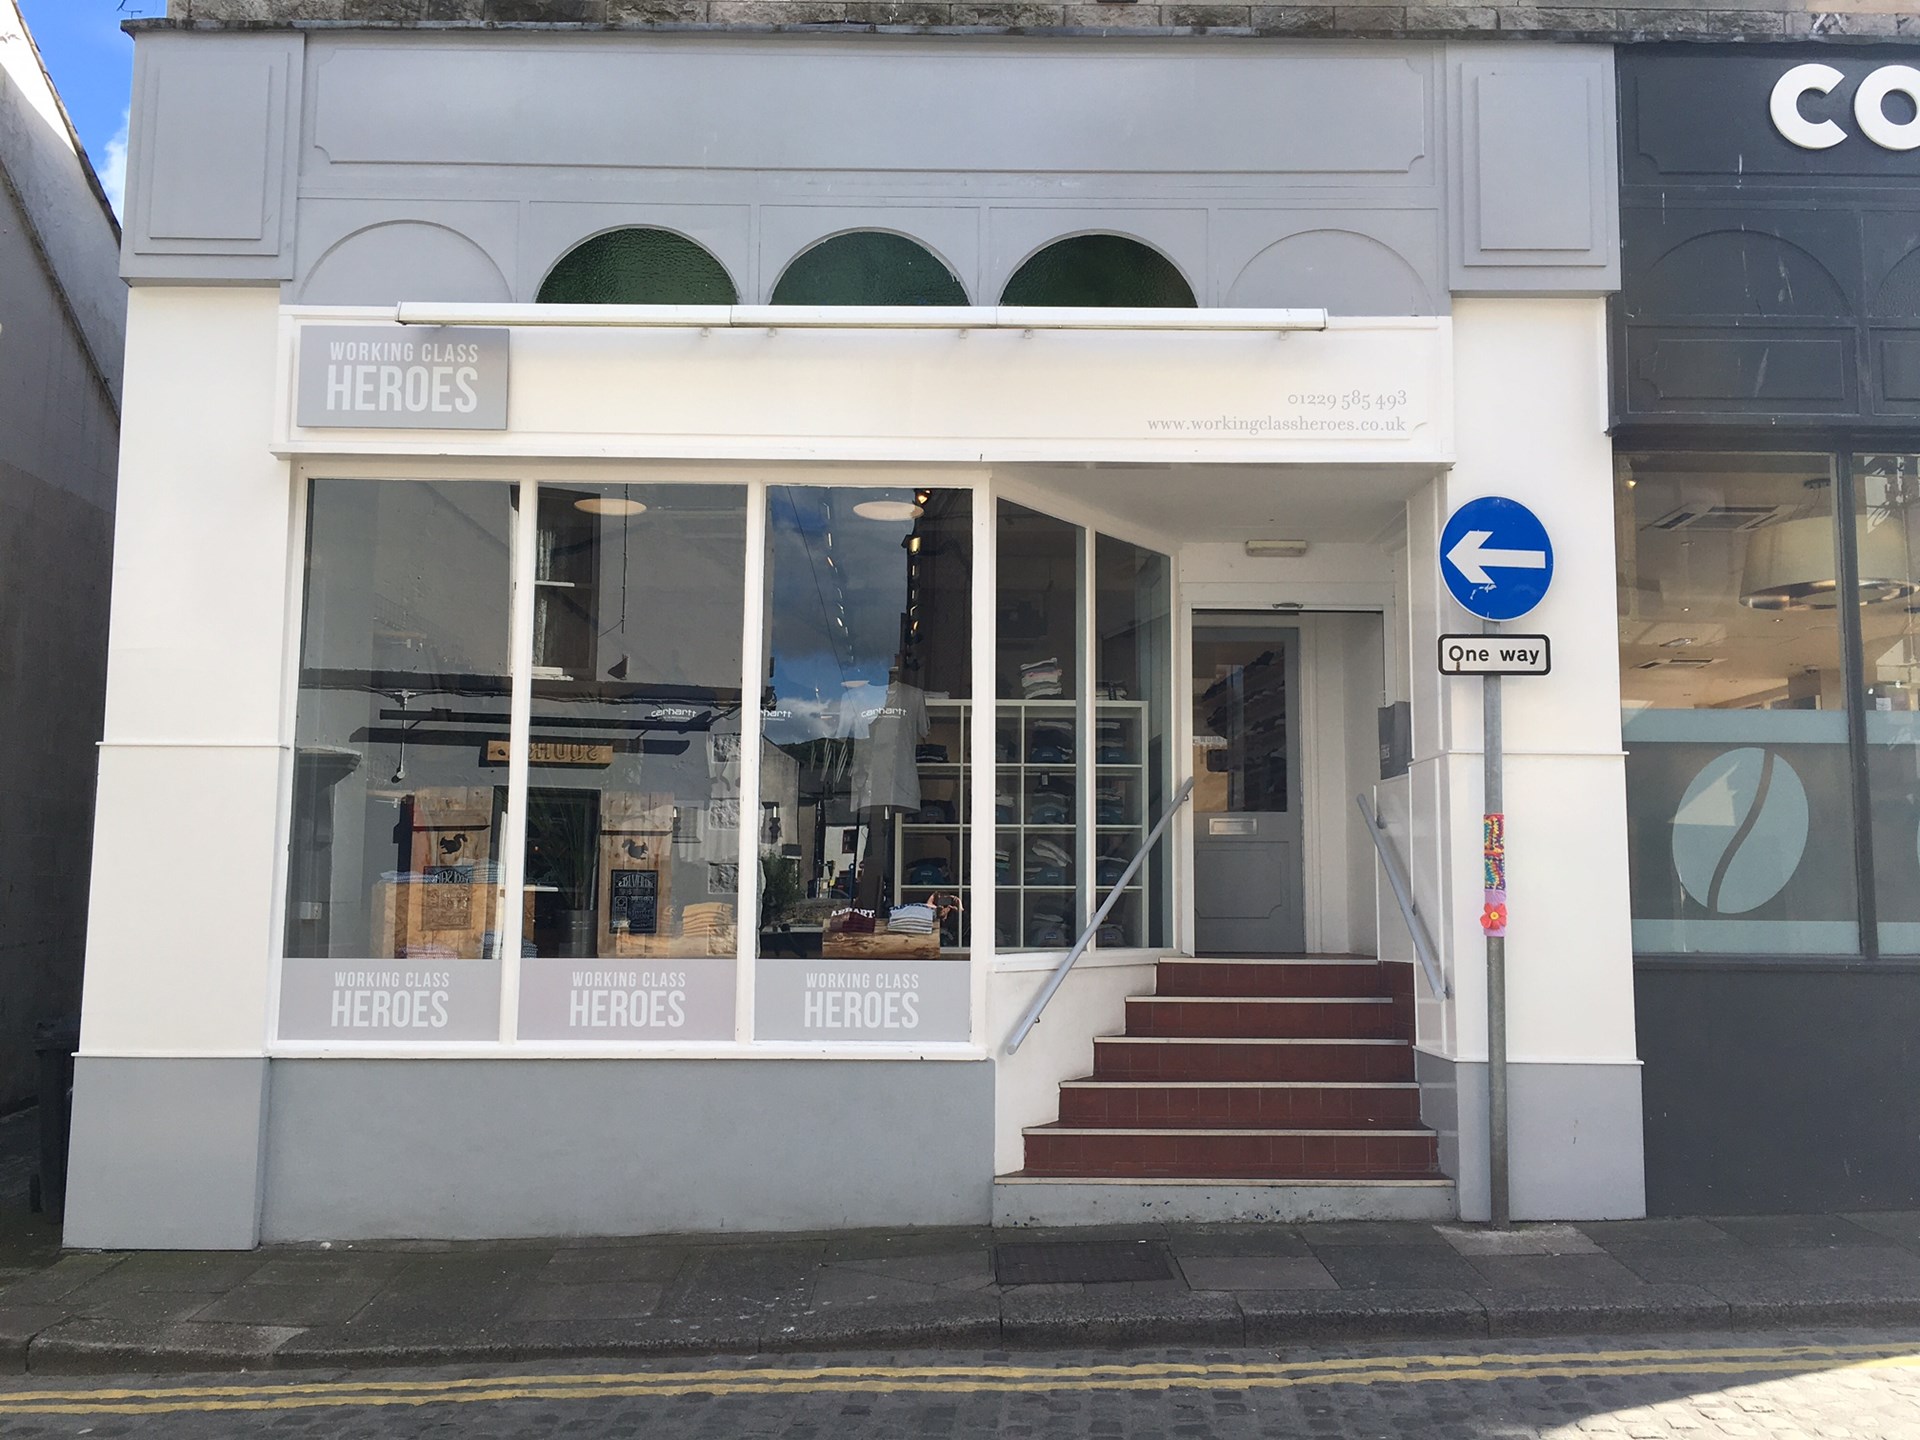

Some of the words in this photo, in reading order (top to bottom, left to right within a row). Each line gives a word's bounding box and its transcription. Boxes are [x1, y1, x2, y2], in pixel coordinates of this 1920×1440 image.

[330, 341, 414, 361] WORKING
[421, 343, 479, 363] CLASS
[326, 364, 479, 413] HEROES
[1287, 393, 1337, 410] 01229
[1341, 389, 1371, 411] 585
[1375, 389, 1408, 411] 493
[1147, 415, 1407, 435] www.workingclassheroes.co.uk
[1448, 645, 1490, 662] One
[1499, 649, 1540, 665] way
[335, 971, 400, 988] WORKING
[405, 971, 450, 988] CLASS
[572, 971, 637, 988] WORKING
[642, 971, 687, 988] CLASS
[806, 972, 871, 989] WORKING
[875, 972, 920, 989] CLASS
[331, 990, 450, 1028] HEROES
[569, 990, 686, 1028] HEROES
[804, 991, 920, 1029] HEROES
